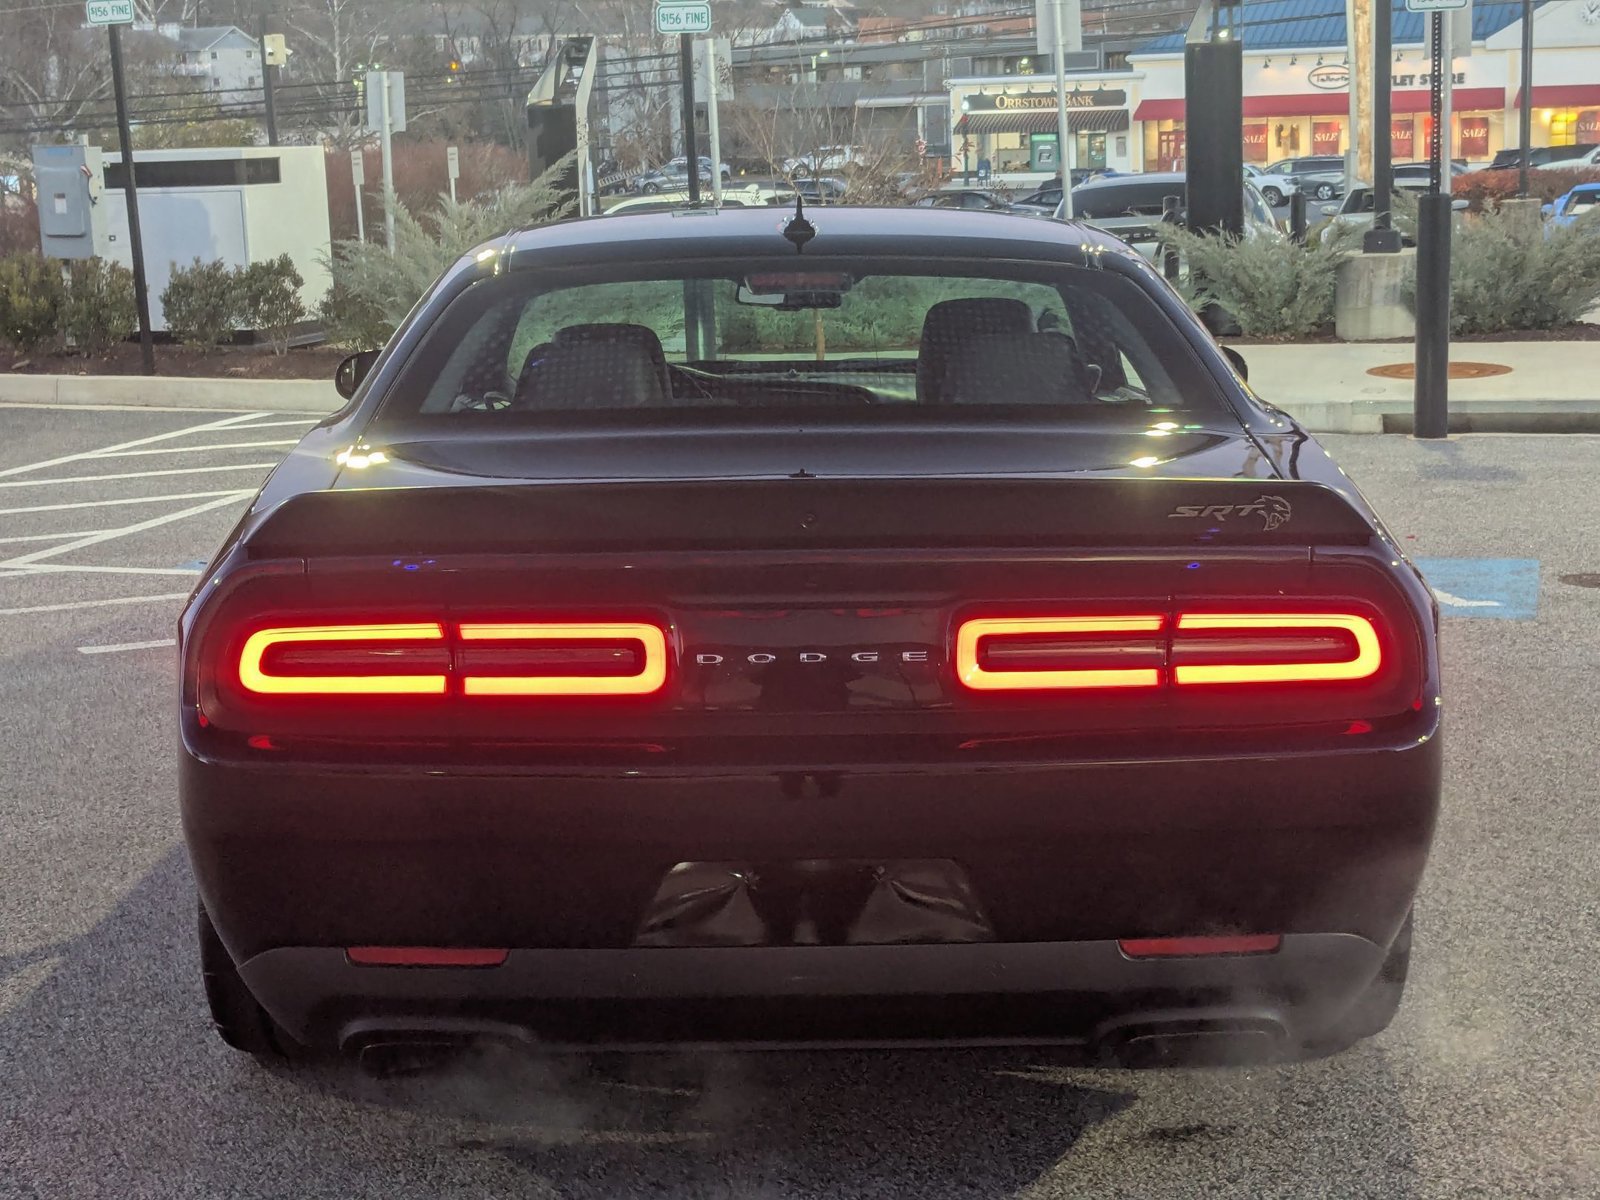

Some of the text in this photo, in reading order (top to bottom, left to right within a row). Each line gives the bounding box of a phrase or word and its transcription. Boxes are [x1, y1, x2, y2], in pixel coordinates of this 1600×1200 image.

[111, 4, 130, 15] FINE
[660, 11, 706, 25] $156 FINE
[1313, 132, 1339, 142] SALE
[1462, 128, 1487, 139] SALE
[1242, 134, 1267, 145] SALE
[1167, 504, 1265, 521] SRT
[696, 650, 928, 664] DODGE
